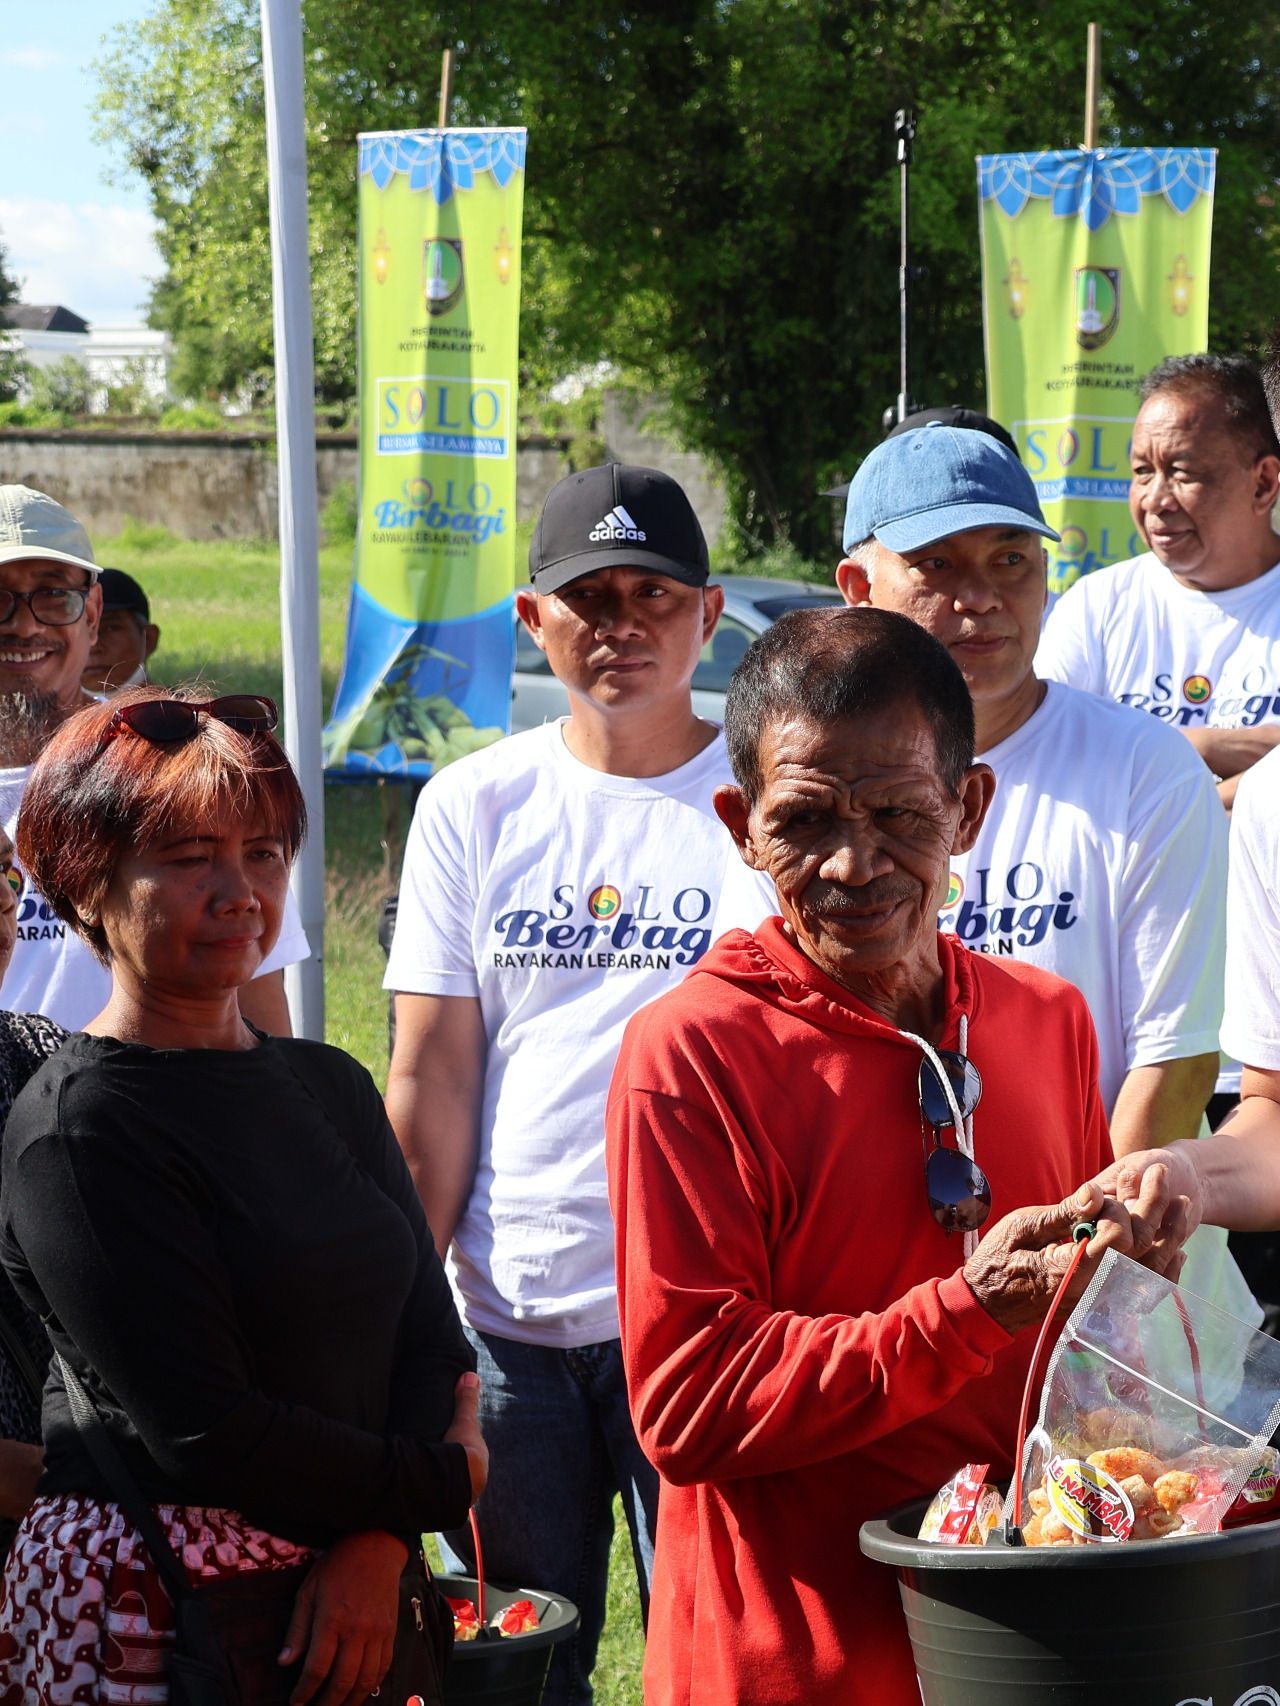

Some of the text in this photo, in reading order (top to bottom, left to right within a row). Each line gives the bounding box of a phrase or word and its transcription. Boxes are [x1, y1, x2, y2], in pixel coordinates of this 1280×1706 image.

[384, 386, 500, 431] SOLO
[1026, 426, 1133, 475] SOL
[588, 526, 647, 542] adidas
[1152, 665, 1266, 704] SOO
[549, 884, 711, 923] SOLO
[936, 891, 1078, 947] rbagi
[17, 924, 66, 941] ARAN
[494, 909, 713, 966] Berbag
[493, 952, 671, 970] RAYAKAN LEBARAN
[1060, 1474, 1133, 1541] NAMBAH
